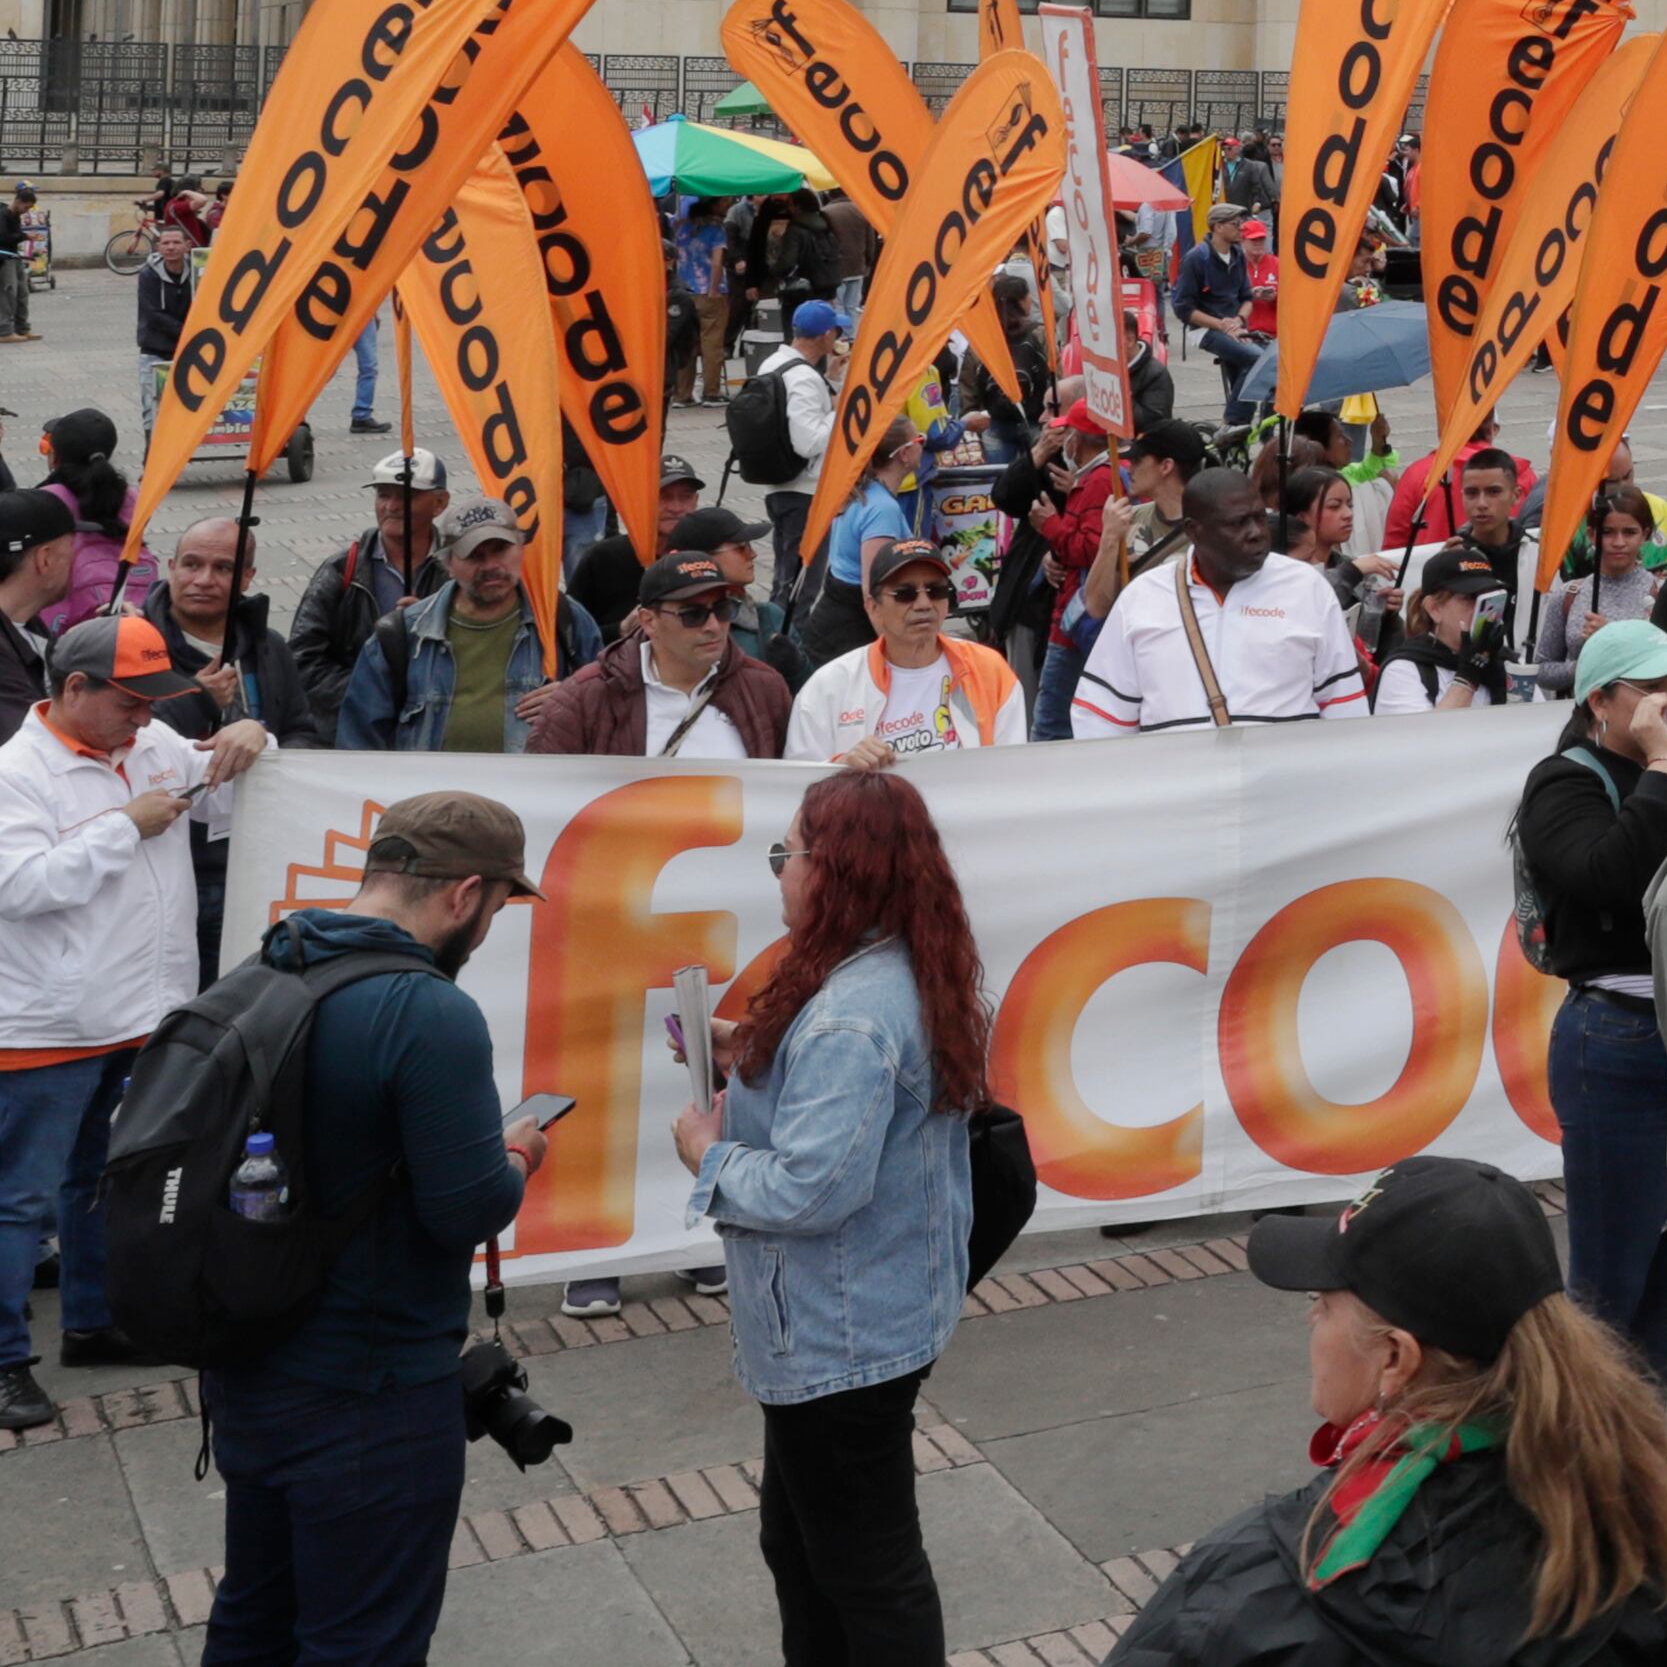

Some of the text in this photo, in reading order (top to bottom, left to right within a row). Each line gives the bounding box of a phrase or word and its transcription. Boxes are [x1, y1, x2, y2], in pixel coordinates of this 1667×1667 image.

[843, 113, 1048, 456] fecode
[880, 711, 925, 734] fecode
[896, 729, 933, 752] voto
[159, 1167, 183, 1224] THULE
